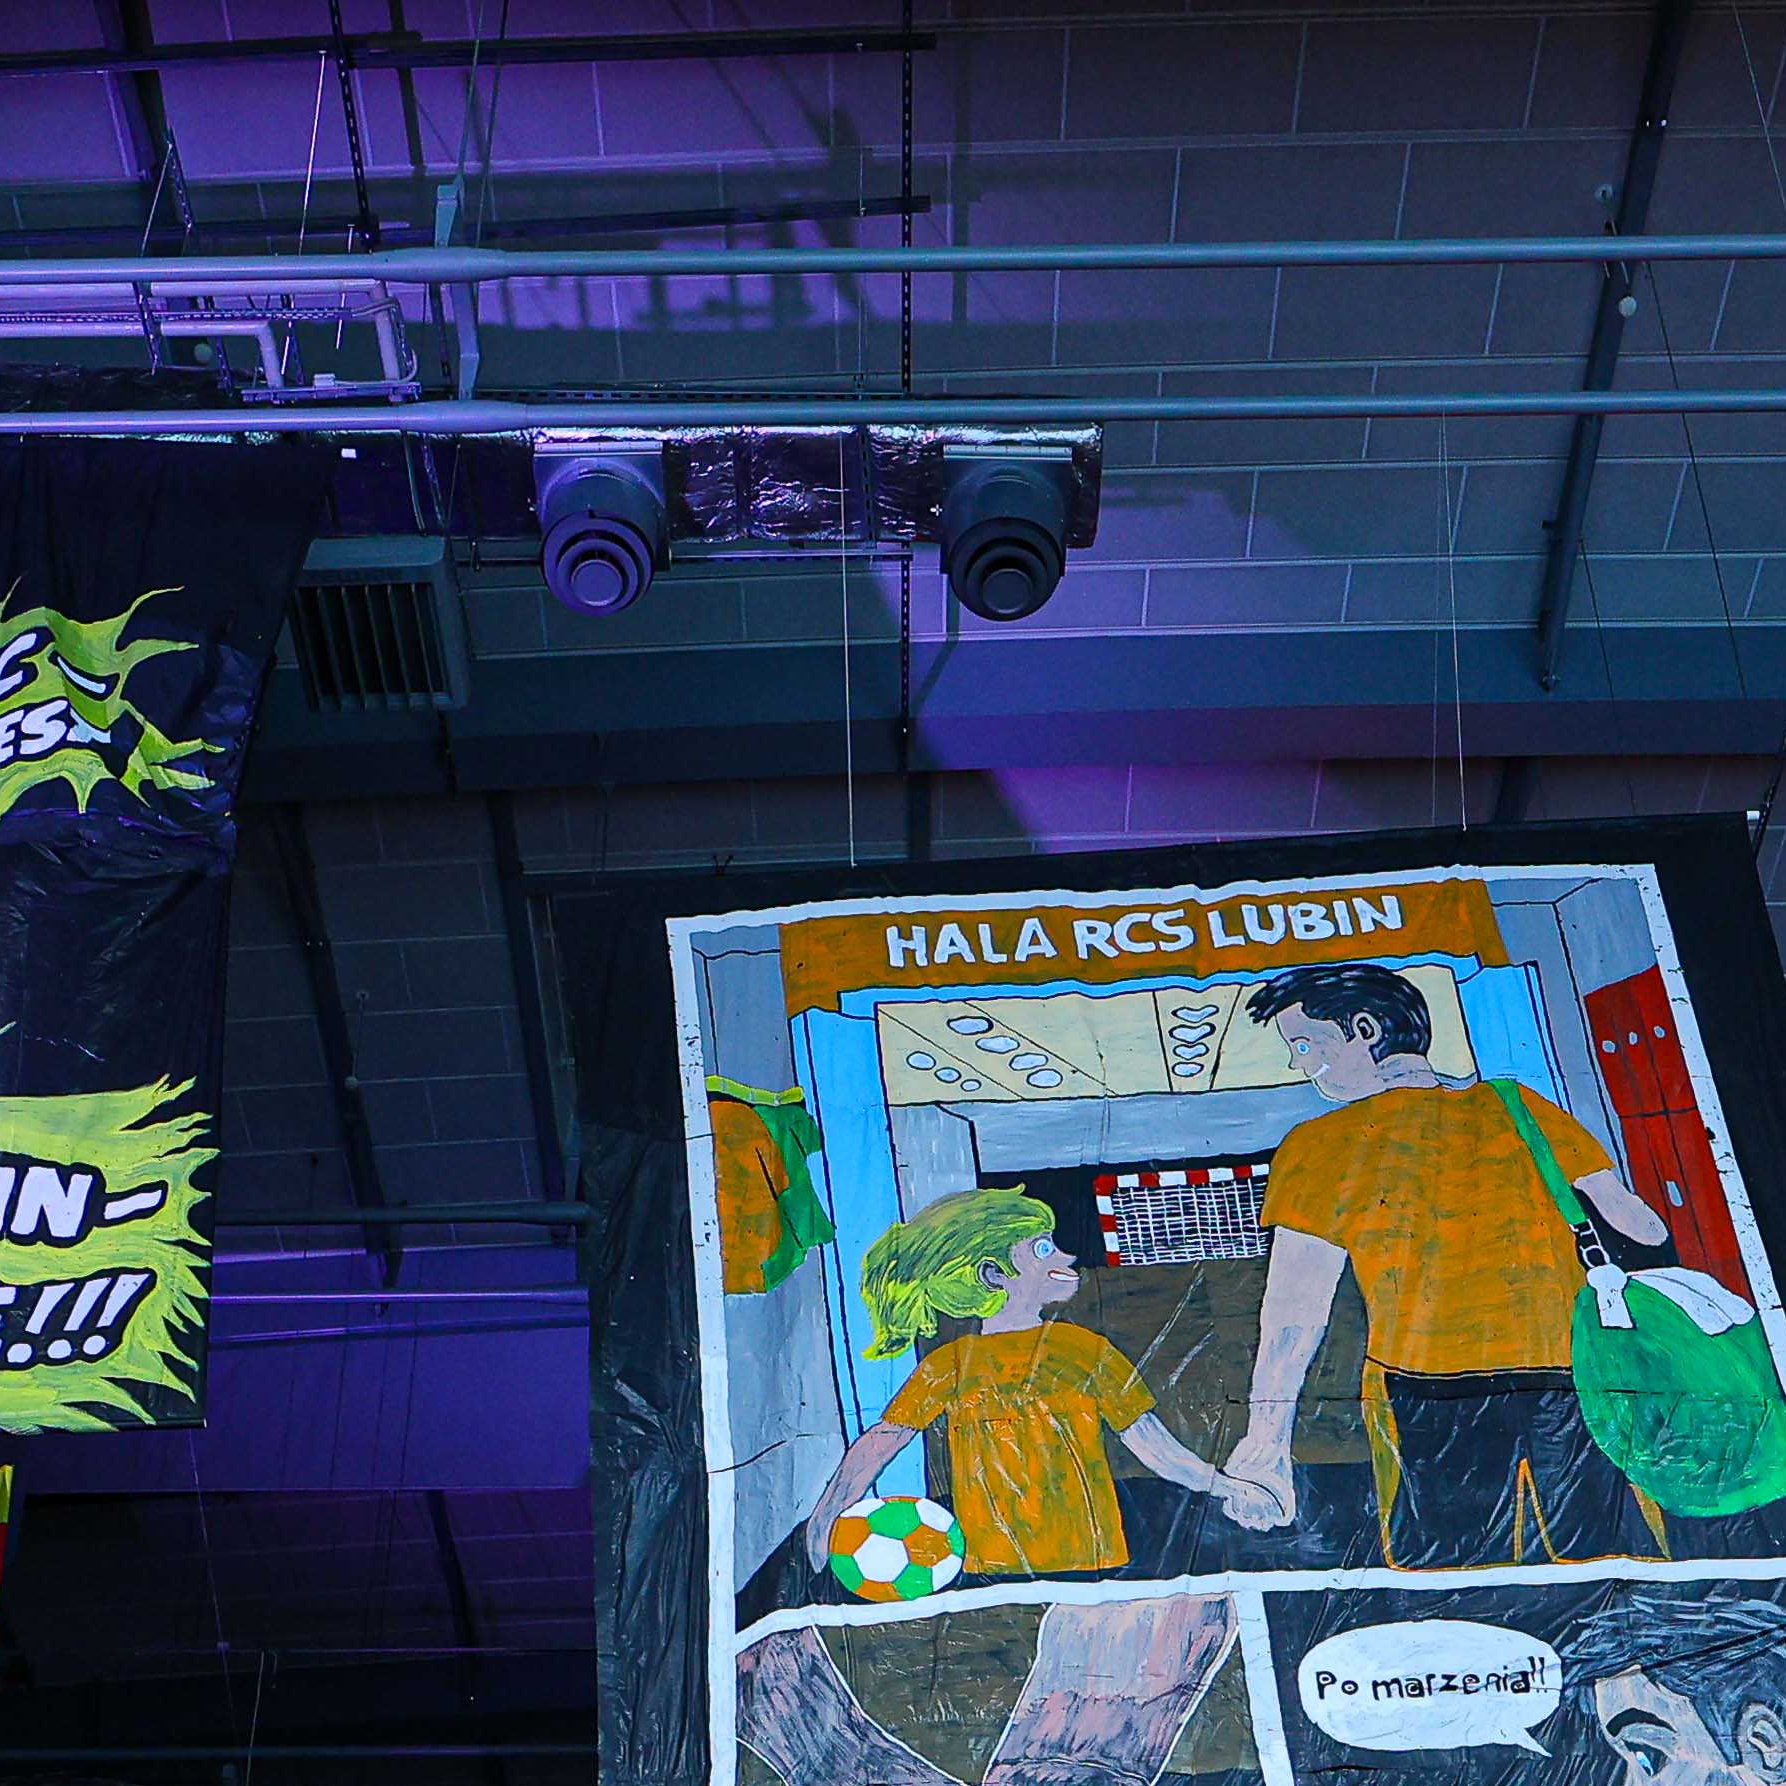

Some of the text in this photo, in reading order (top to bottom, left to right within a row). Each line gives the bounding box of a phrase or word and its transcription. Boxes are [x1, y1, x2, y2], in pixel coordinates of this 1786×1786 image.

[886, 894, 1403, 968] HALA RCS LUBIN
[1316, 1655, 1547, 1701] Po marzenia!!
